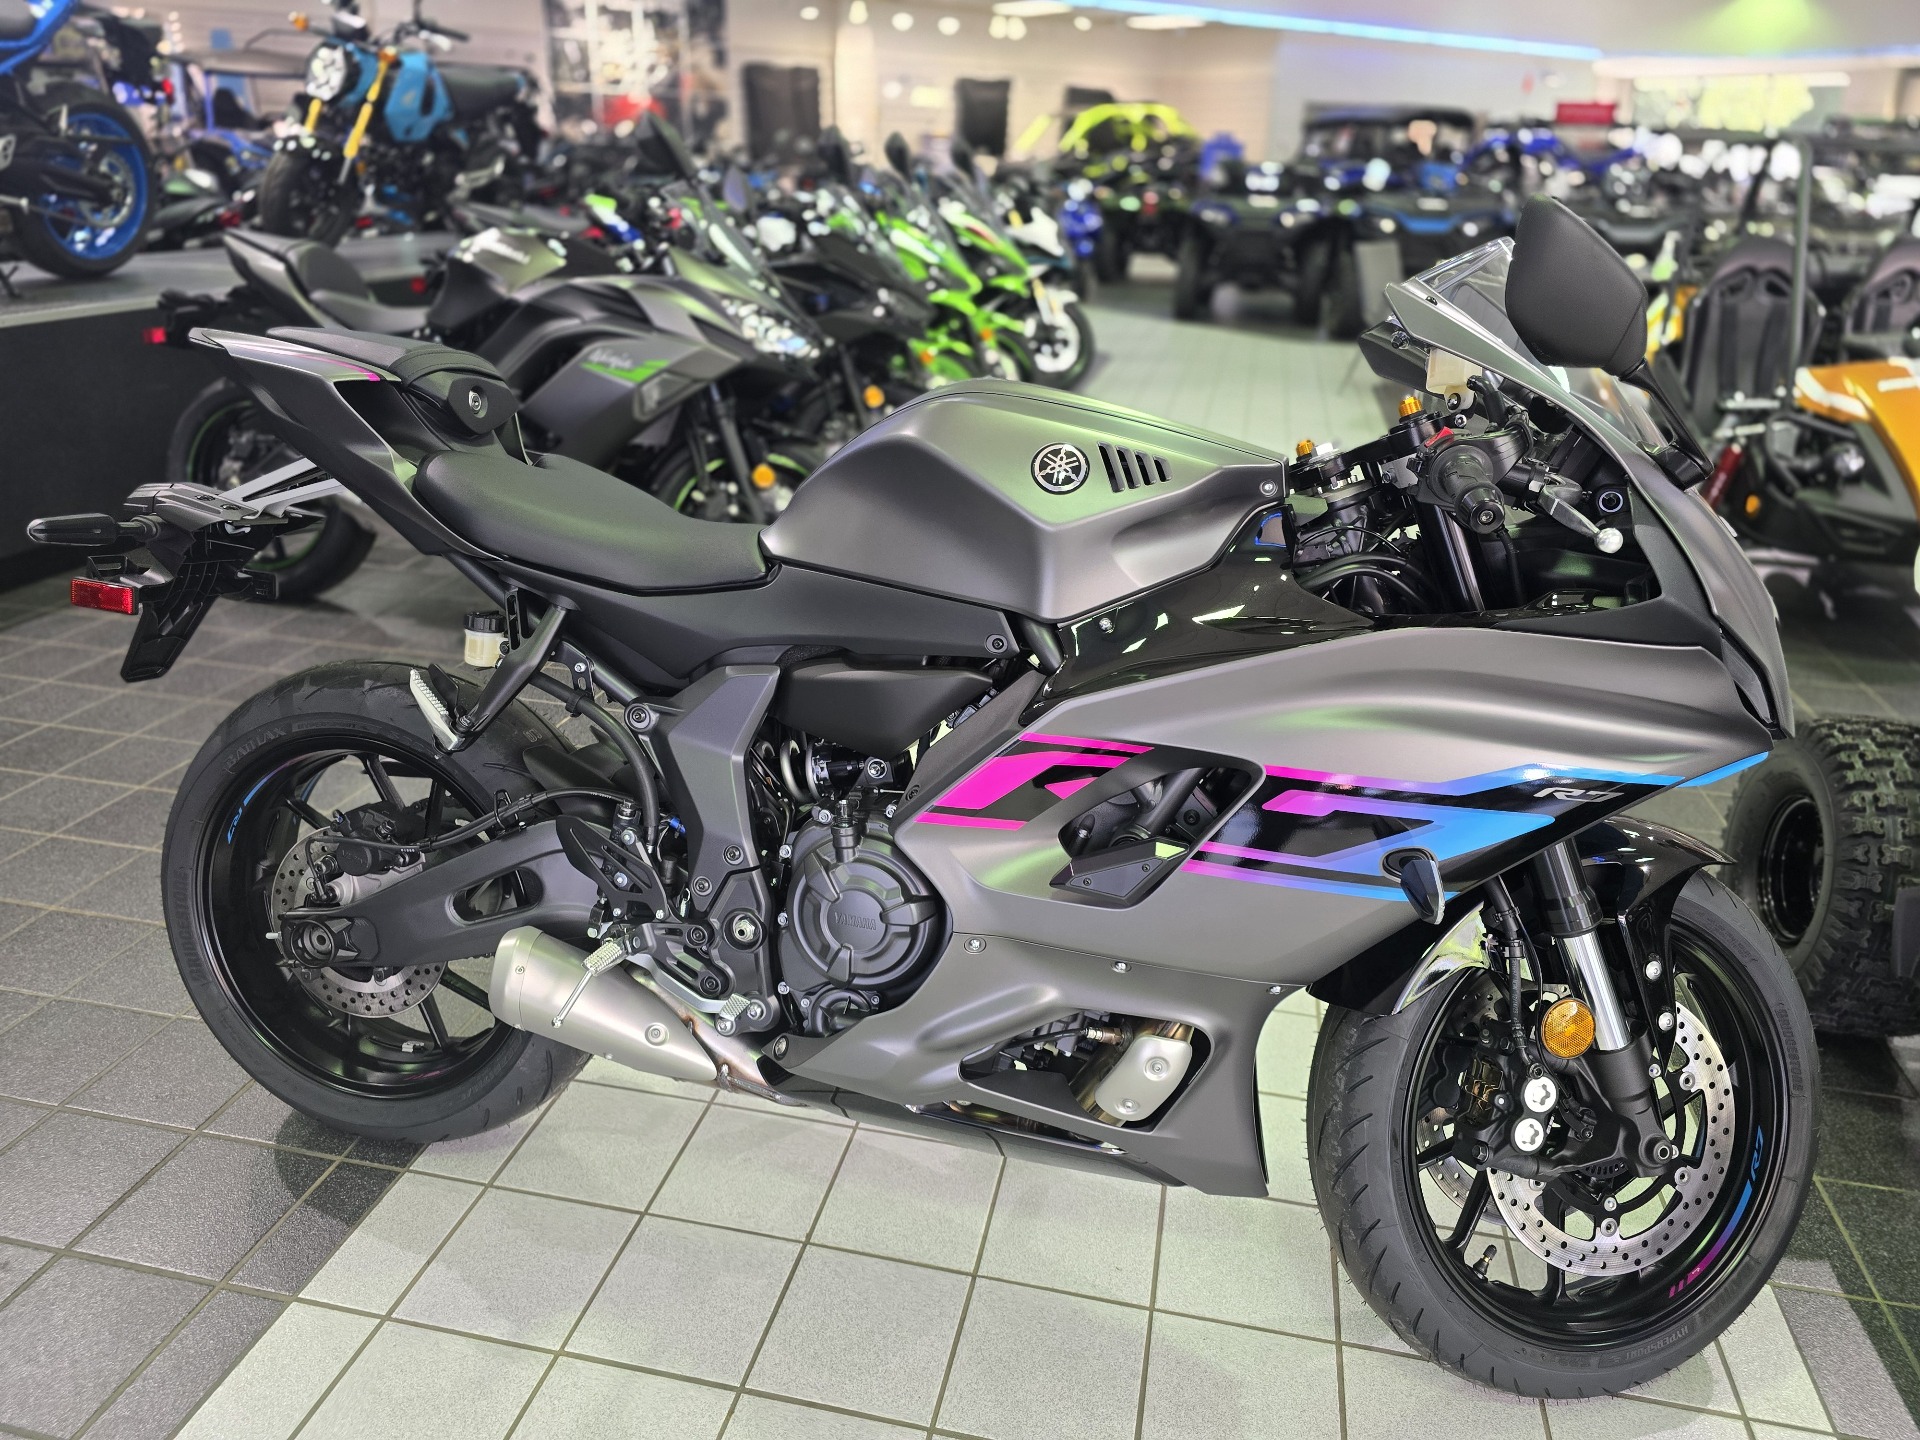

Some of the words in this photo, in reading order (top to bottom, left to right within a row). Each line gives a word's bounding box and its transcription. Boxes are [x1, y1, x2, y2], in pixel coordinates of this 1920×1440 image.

[1533, 787, 1625, 803] R7
[834, 911, 877, 931] YAMAHA
[1774, 1006, 1804, 1095] BRIDGESTONE
[1750, 1124, 1764, 1183] R7
[1625, 1324, 1690, 1361] HYPERSPORT
